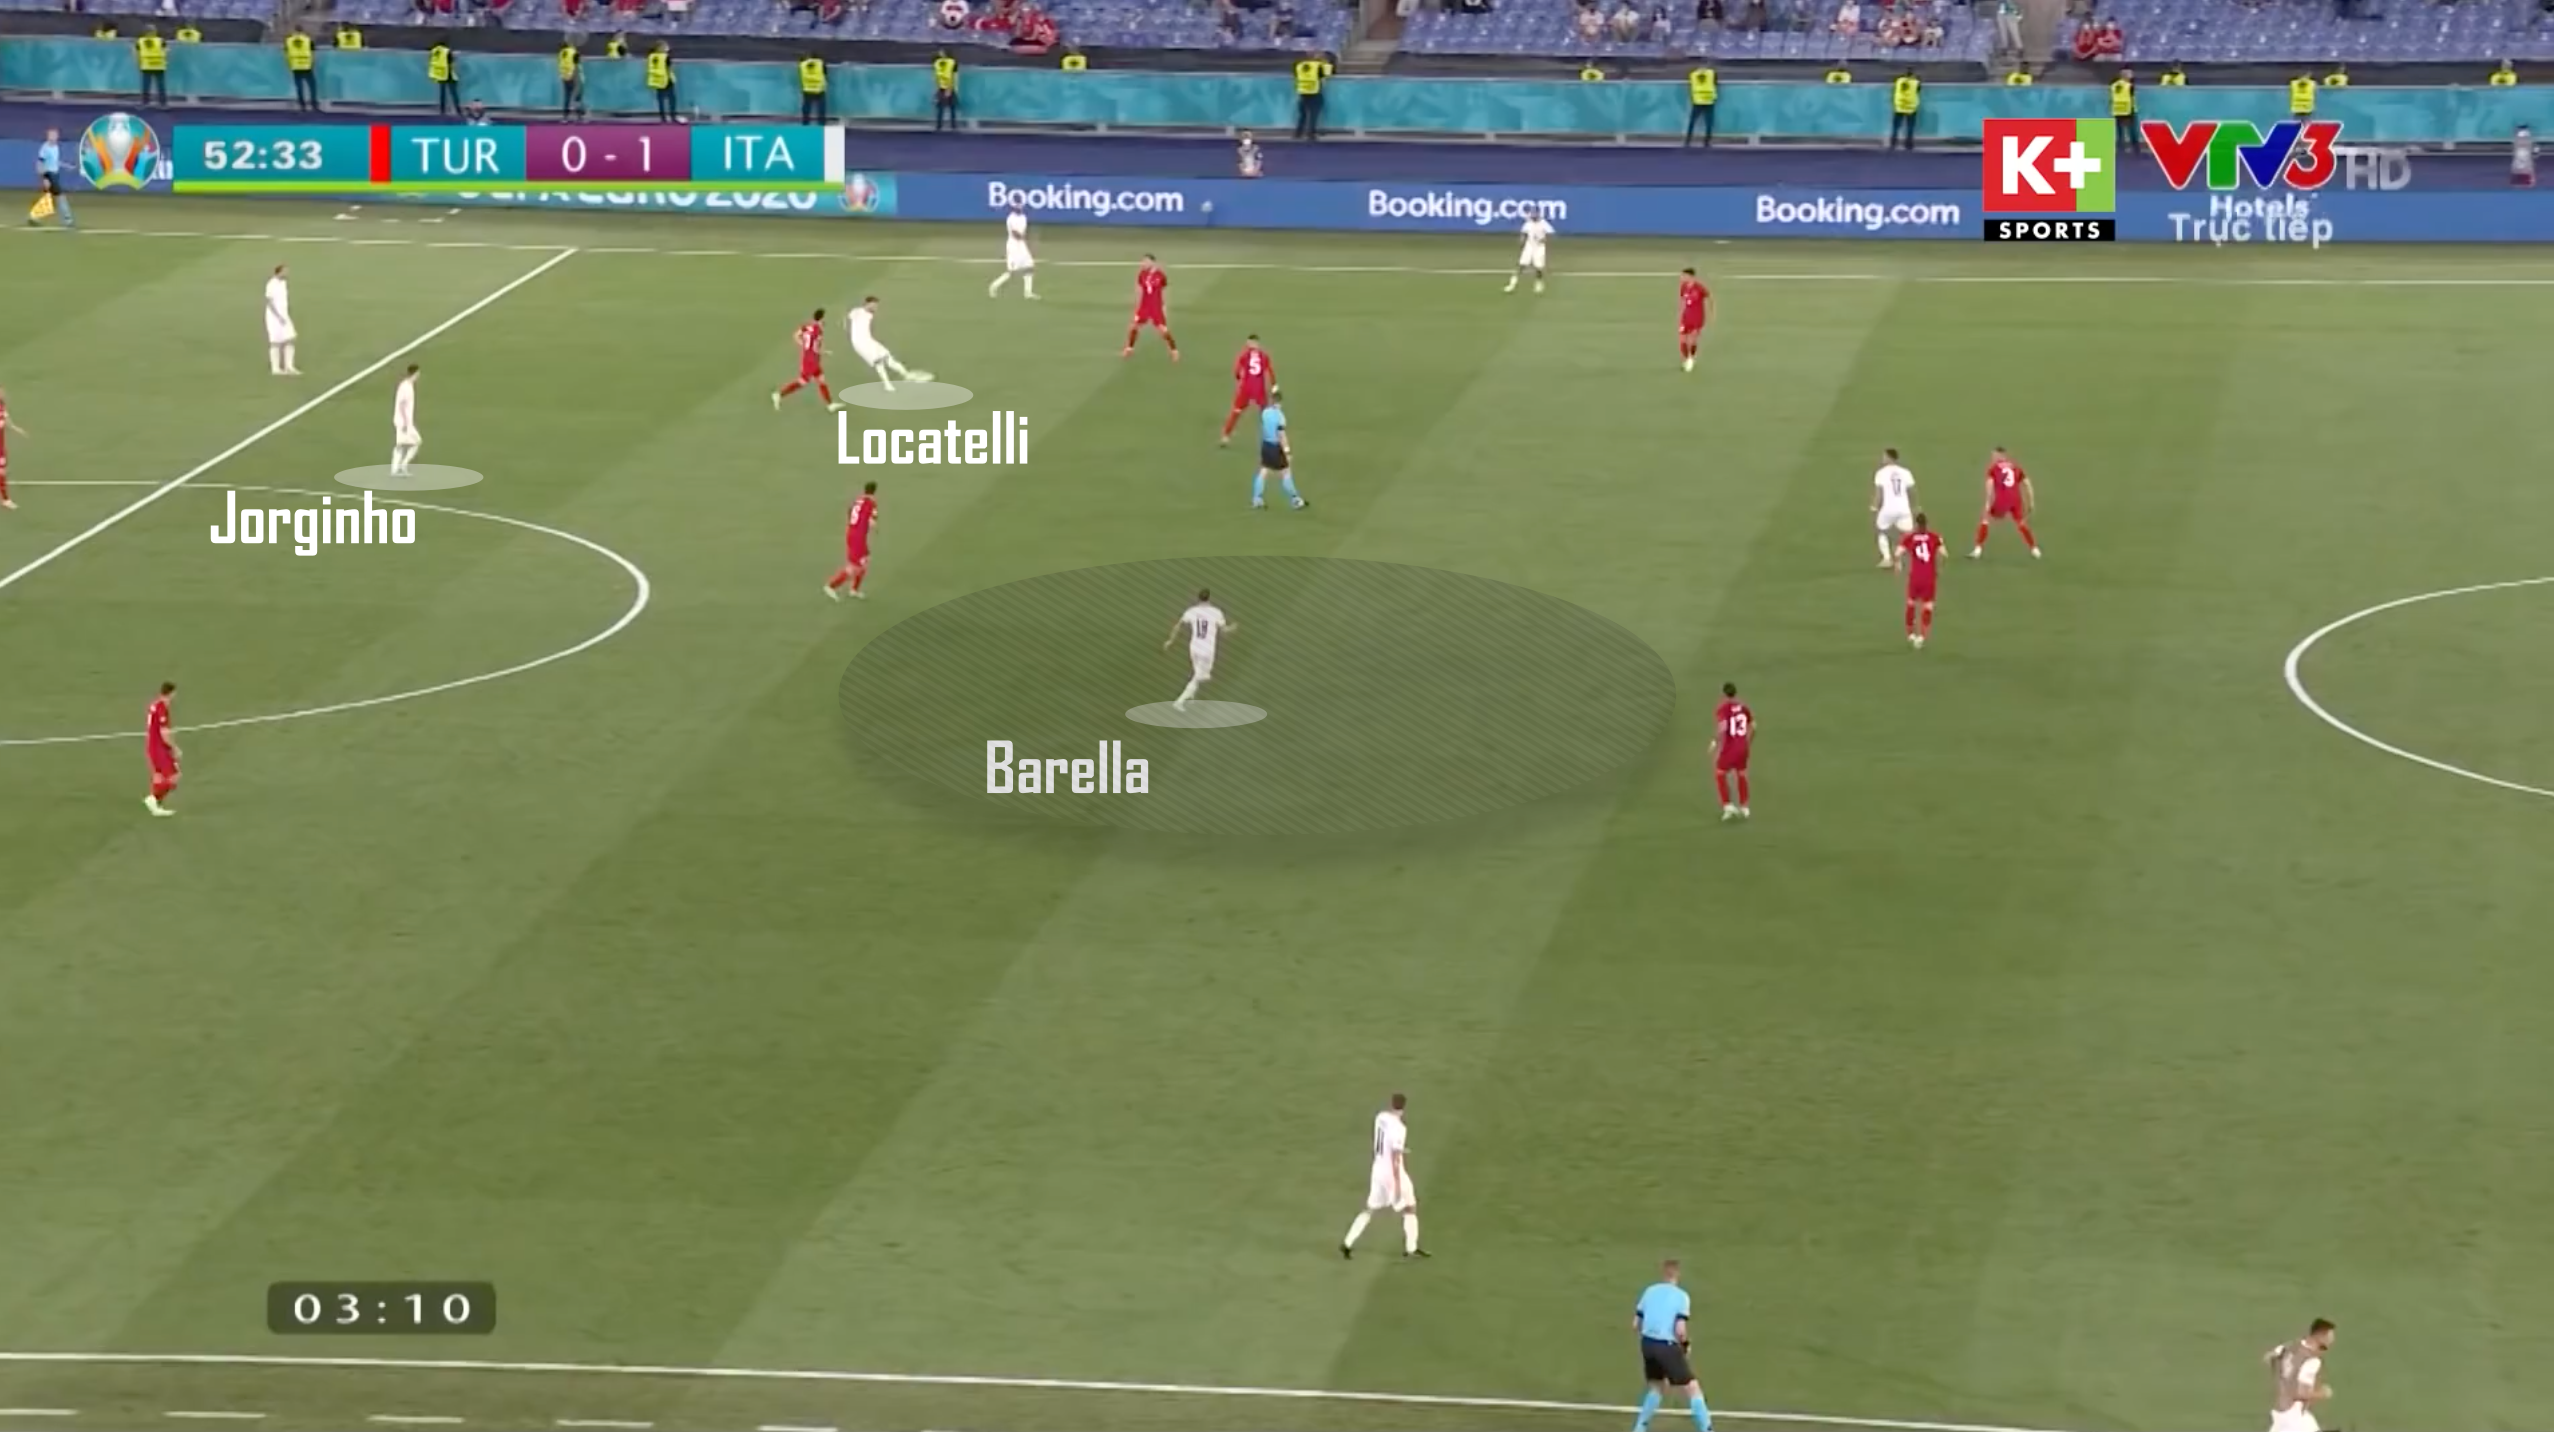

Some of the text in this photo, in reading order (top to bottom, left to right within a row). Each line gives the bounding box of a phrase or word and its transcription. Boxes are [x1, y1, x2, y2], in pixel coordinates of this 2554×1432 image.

[987, 181, 1184, 217] Booking.com
[1368, 189, 1567, 225] Booking.com
[1756, 195, 1960, 230] Booking.com
[1248, 355, 1262, 375] 5
[1915, 541, 1930, 562] 4
[1729, 713, 1747, 736] 13
